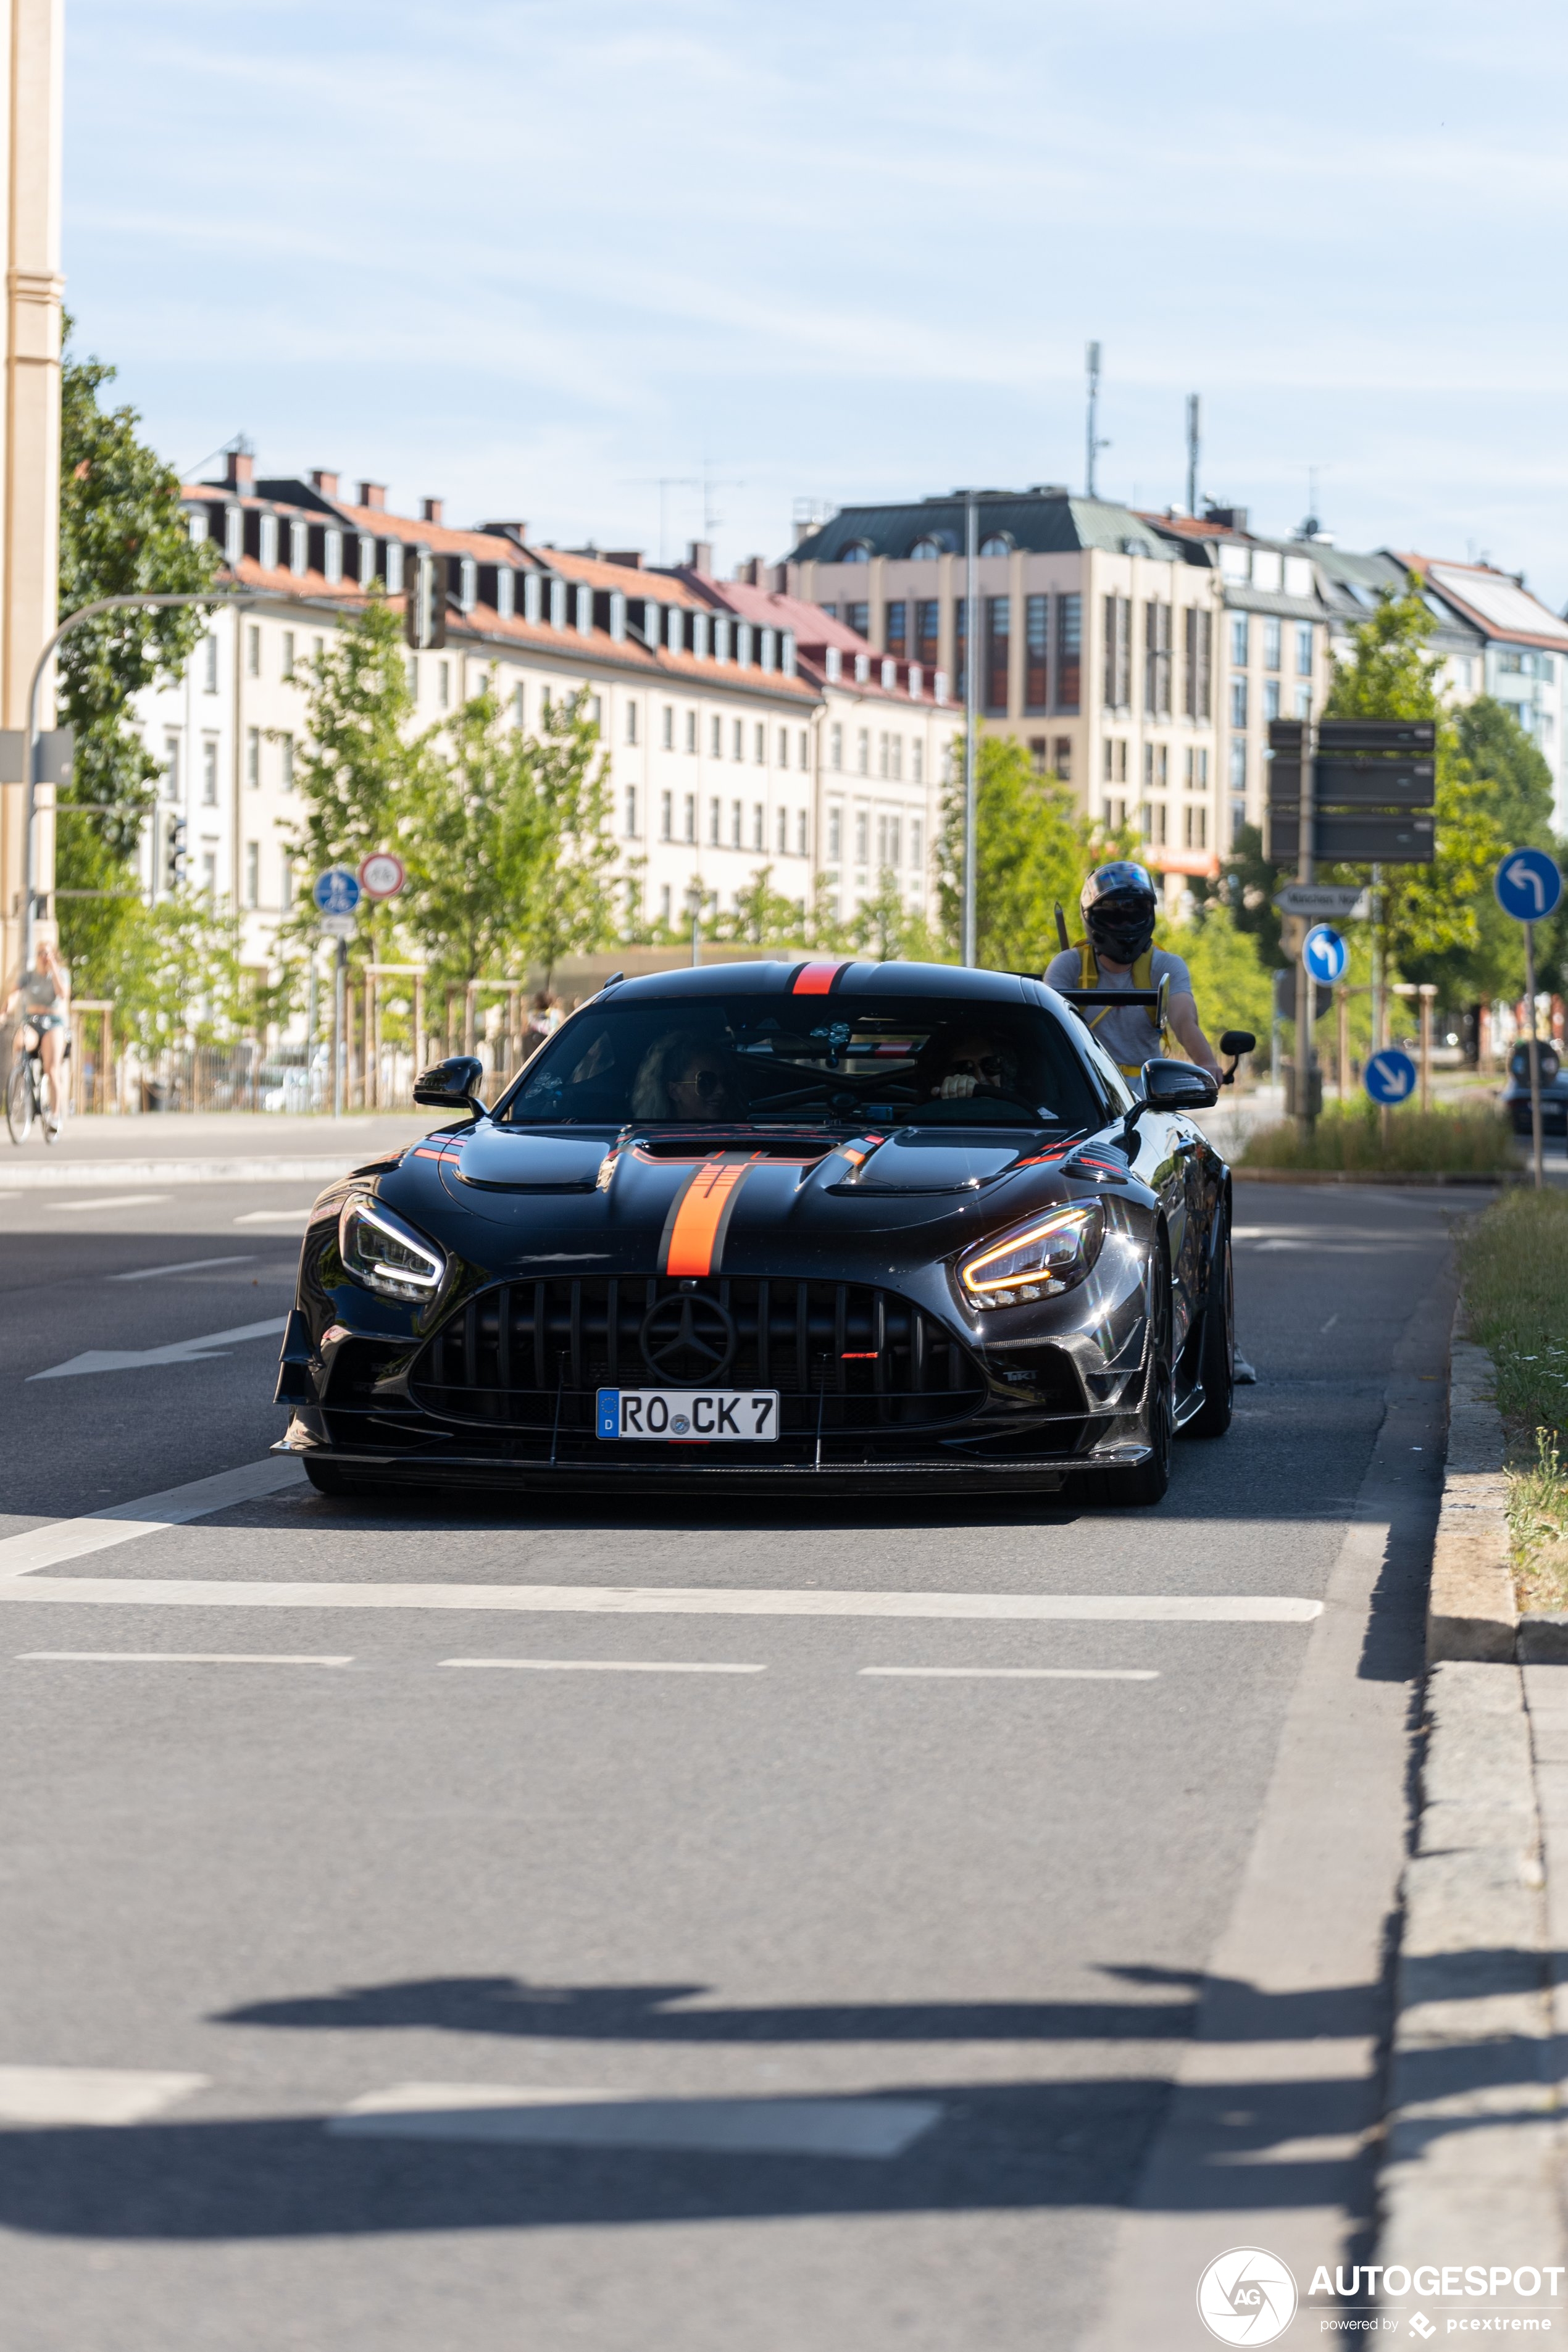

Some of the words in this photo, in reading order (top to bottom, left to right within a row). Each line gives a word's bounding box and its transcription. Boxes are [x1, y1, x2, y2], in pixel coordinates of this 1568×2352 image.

[604, 1419, 613, 1430] D
[621, 1396, 669, 1432] RO
[692, 1397, 741, 1433] CK
[751, 1398, 774, 1433] 7
